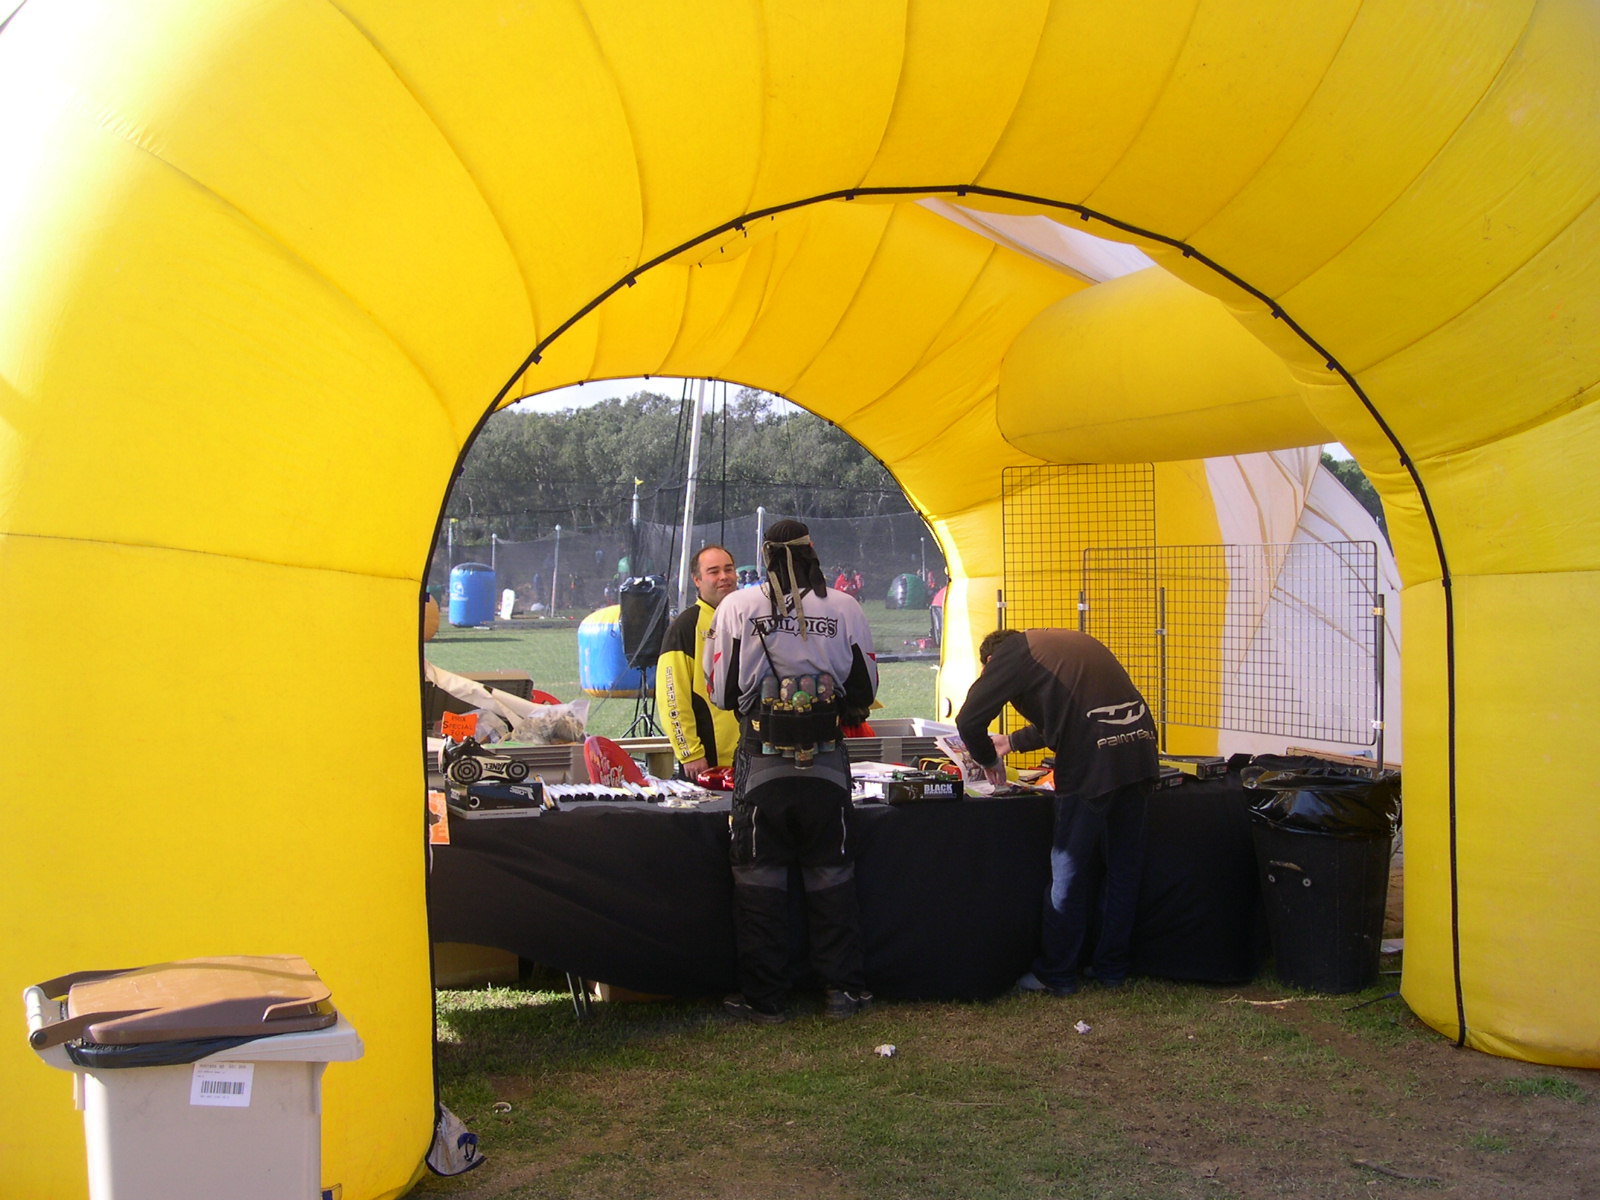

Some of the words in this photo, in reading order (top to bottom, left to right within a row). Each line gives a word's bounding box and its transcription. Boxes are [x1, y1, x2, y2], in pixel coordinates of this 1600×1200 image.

[756, 617, 796, 633] VIL
[671, 720, 691, 758] PARTS
[923, 783, 953, 795] BLACK
